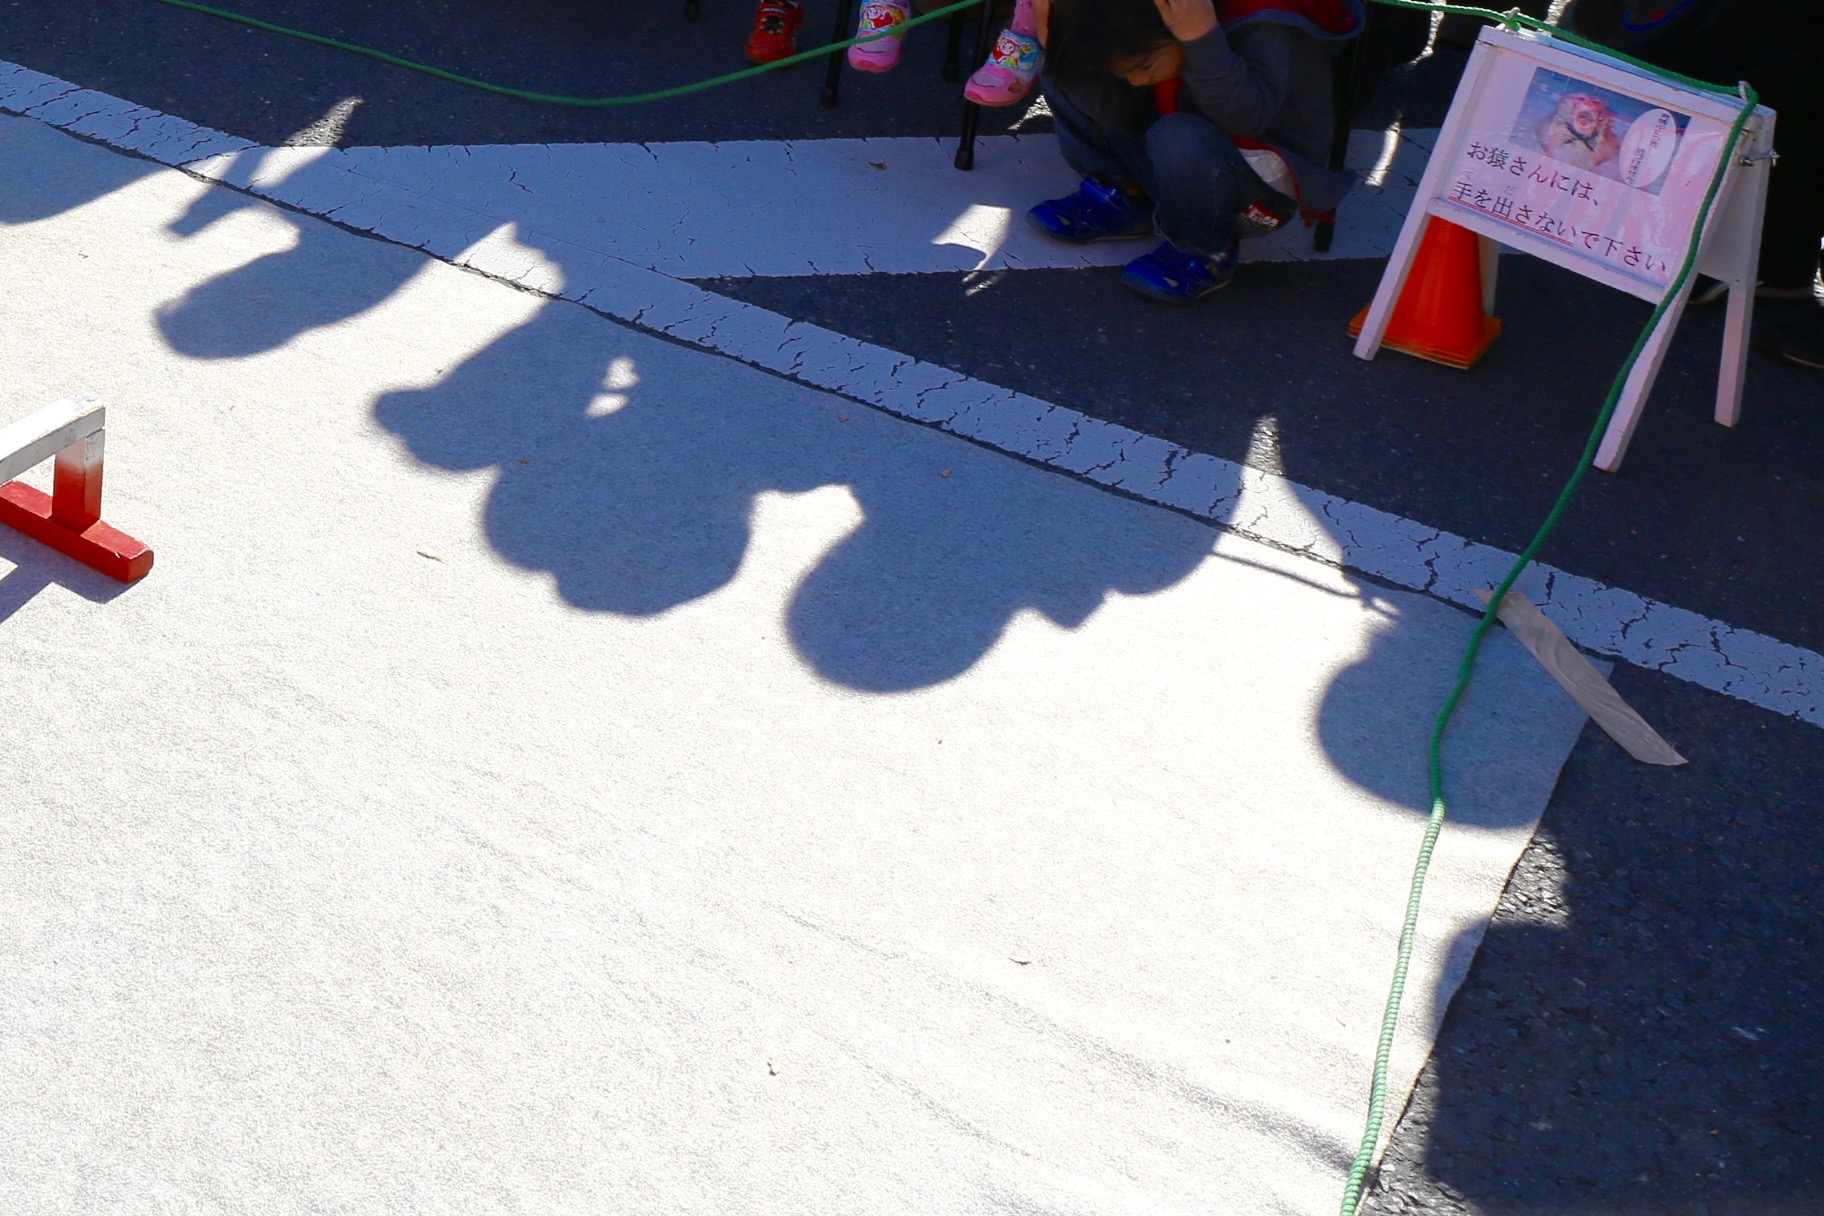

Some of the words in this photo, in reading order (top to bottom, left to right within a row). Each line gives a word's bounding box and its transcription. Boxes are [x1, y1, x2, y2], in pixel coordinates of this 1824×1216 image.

[1466, 141, 1599, 206] お猿さんには、
[1453, 181, 1666, 272] 手を出さないで下さい
